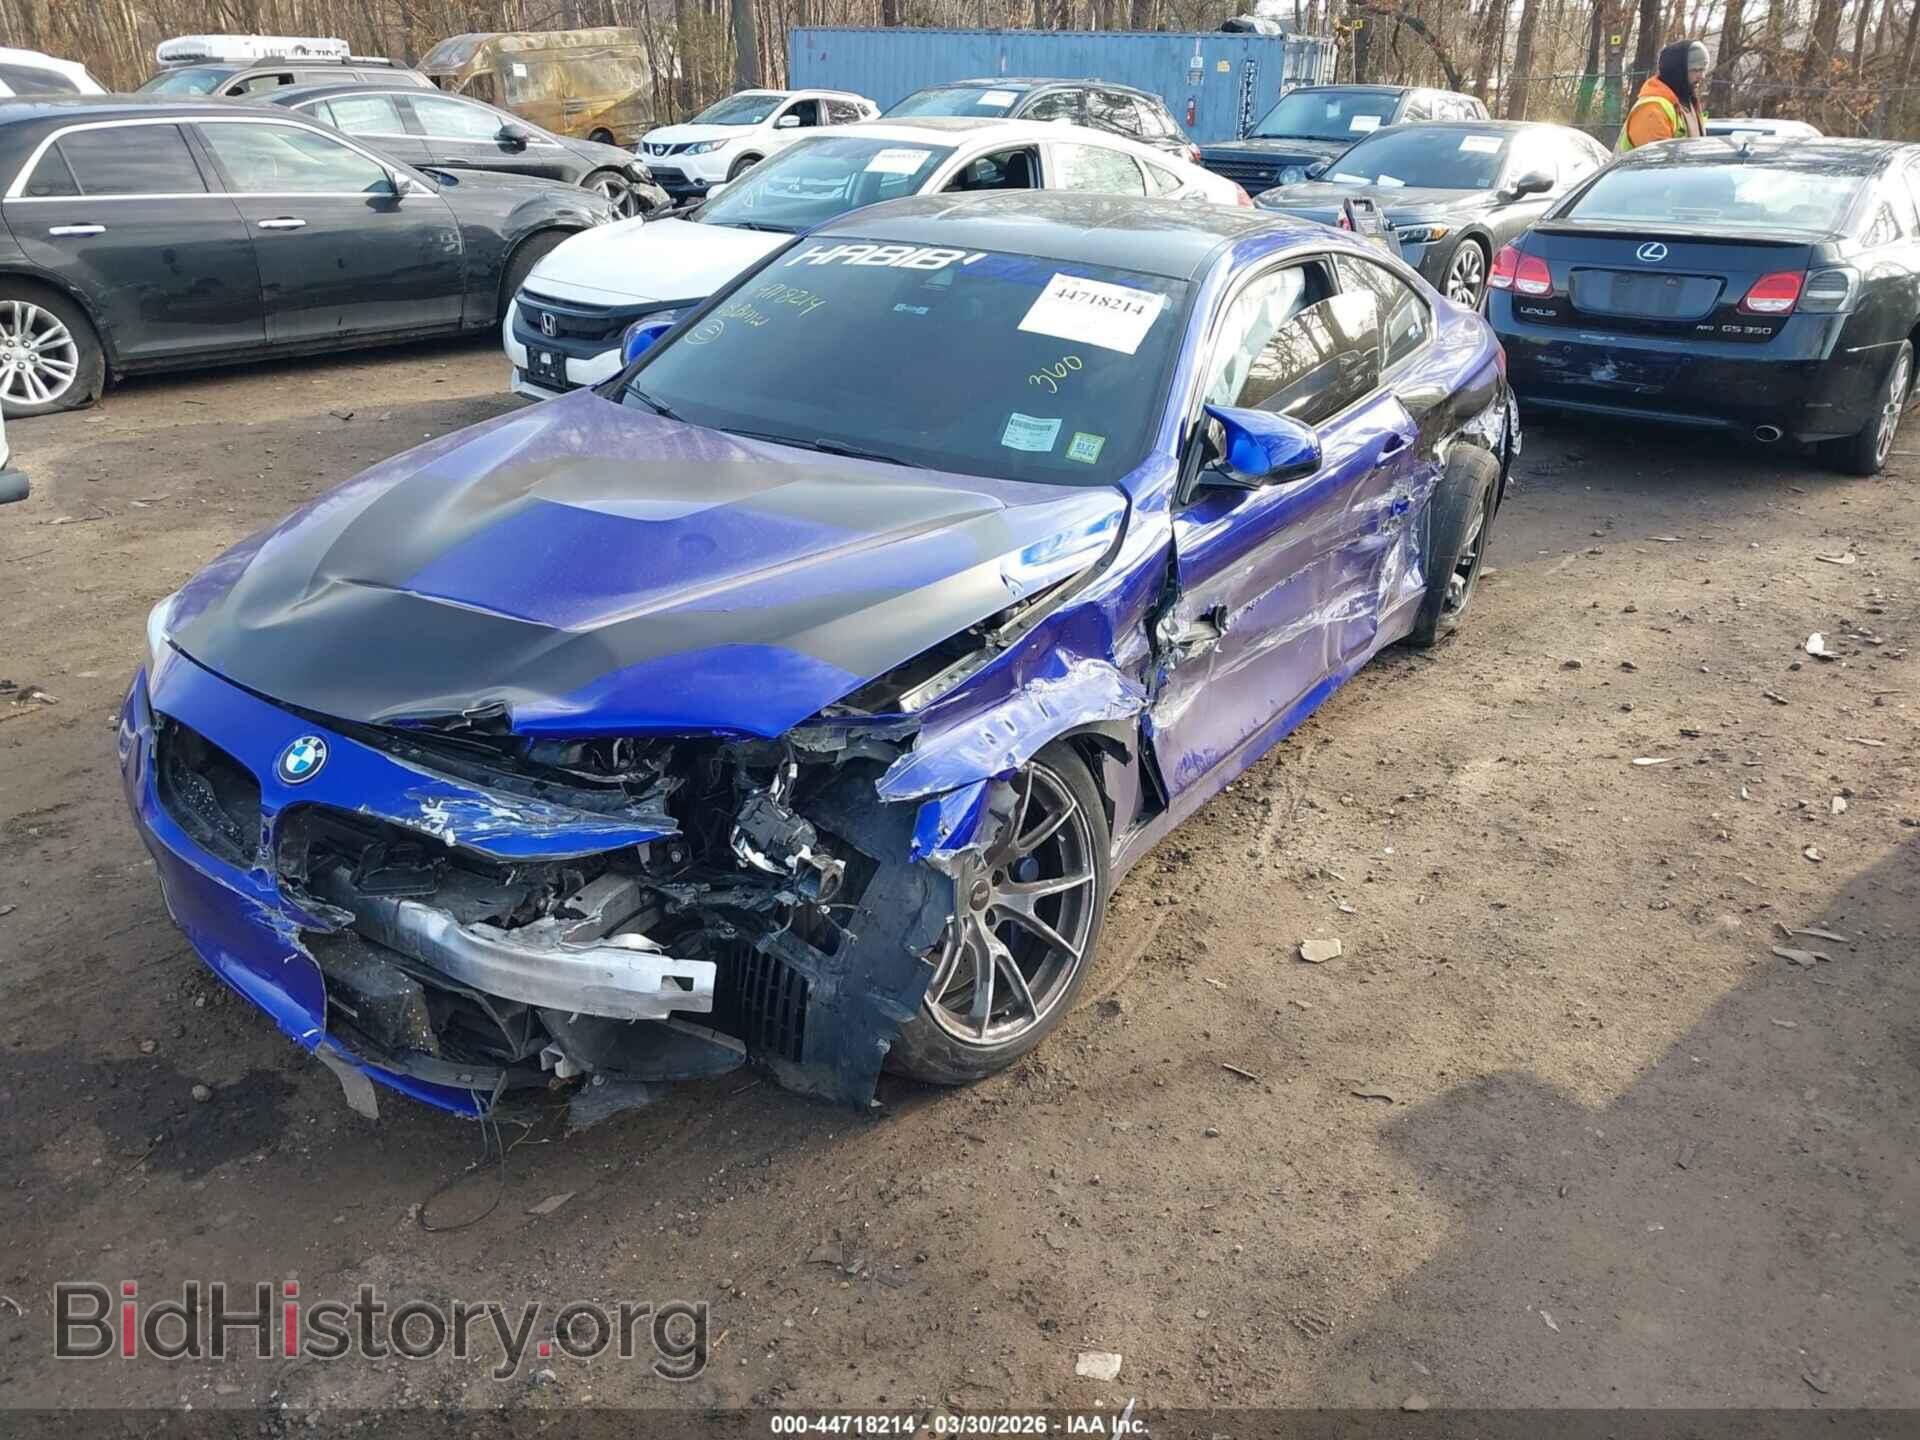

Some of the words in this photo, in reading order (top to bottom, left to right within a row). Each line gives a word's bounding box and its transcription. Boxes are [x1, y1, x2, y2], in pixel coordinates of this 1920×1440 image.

[1054, 287, 1146, 316] 44718214
[1520, 305, 1558, 317] LEXUS
[1721, 324, 1742, 334] GS
[1743, 326, 1772, 335] 350
[1029, 355, 1083, 394] 360
